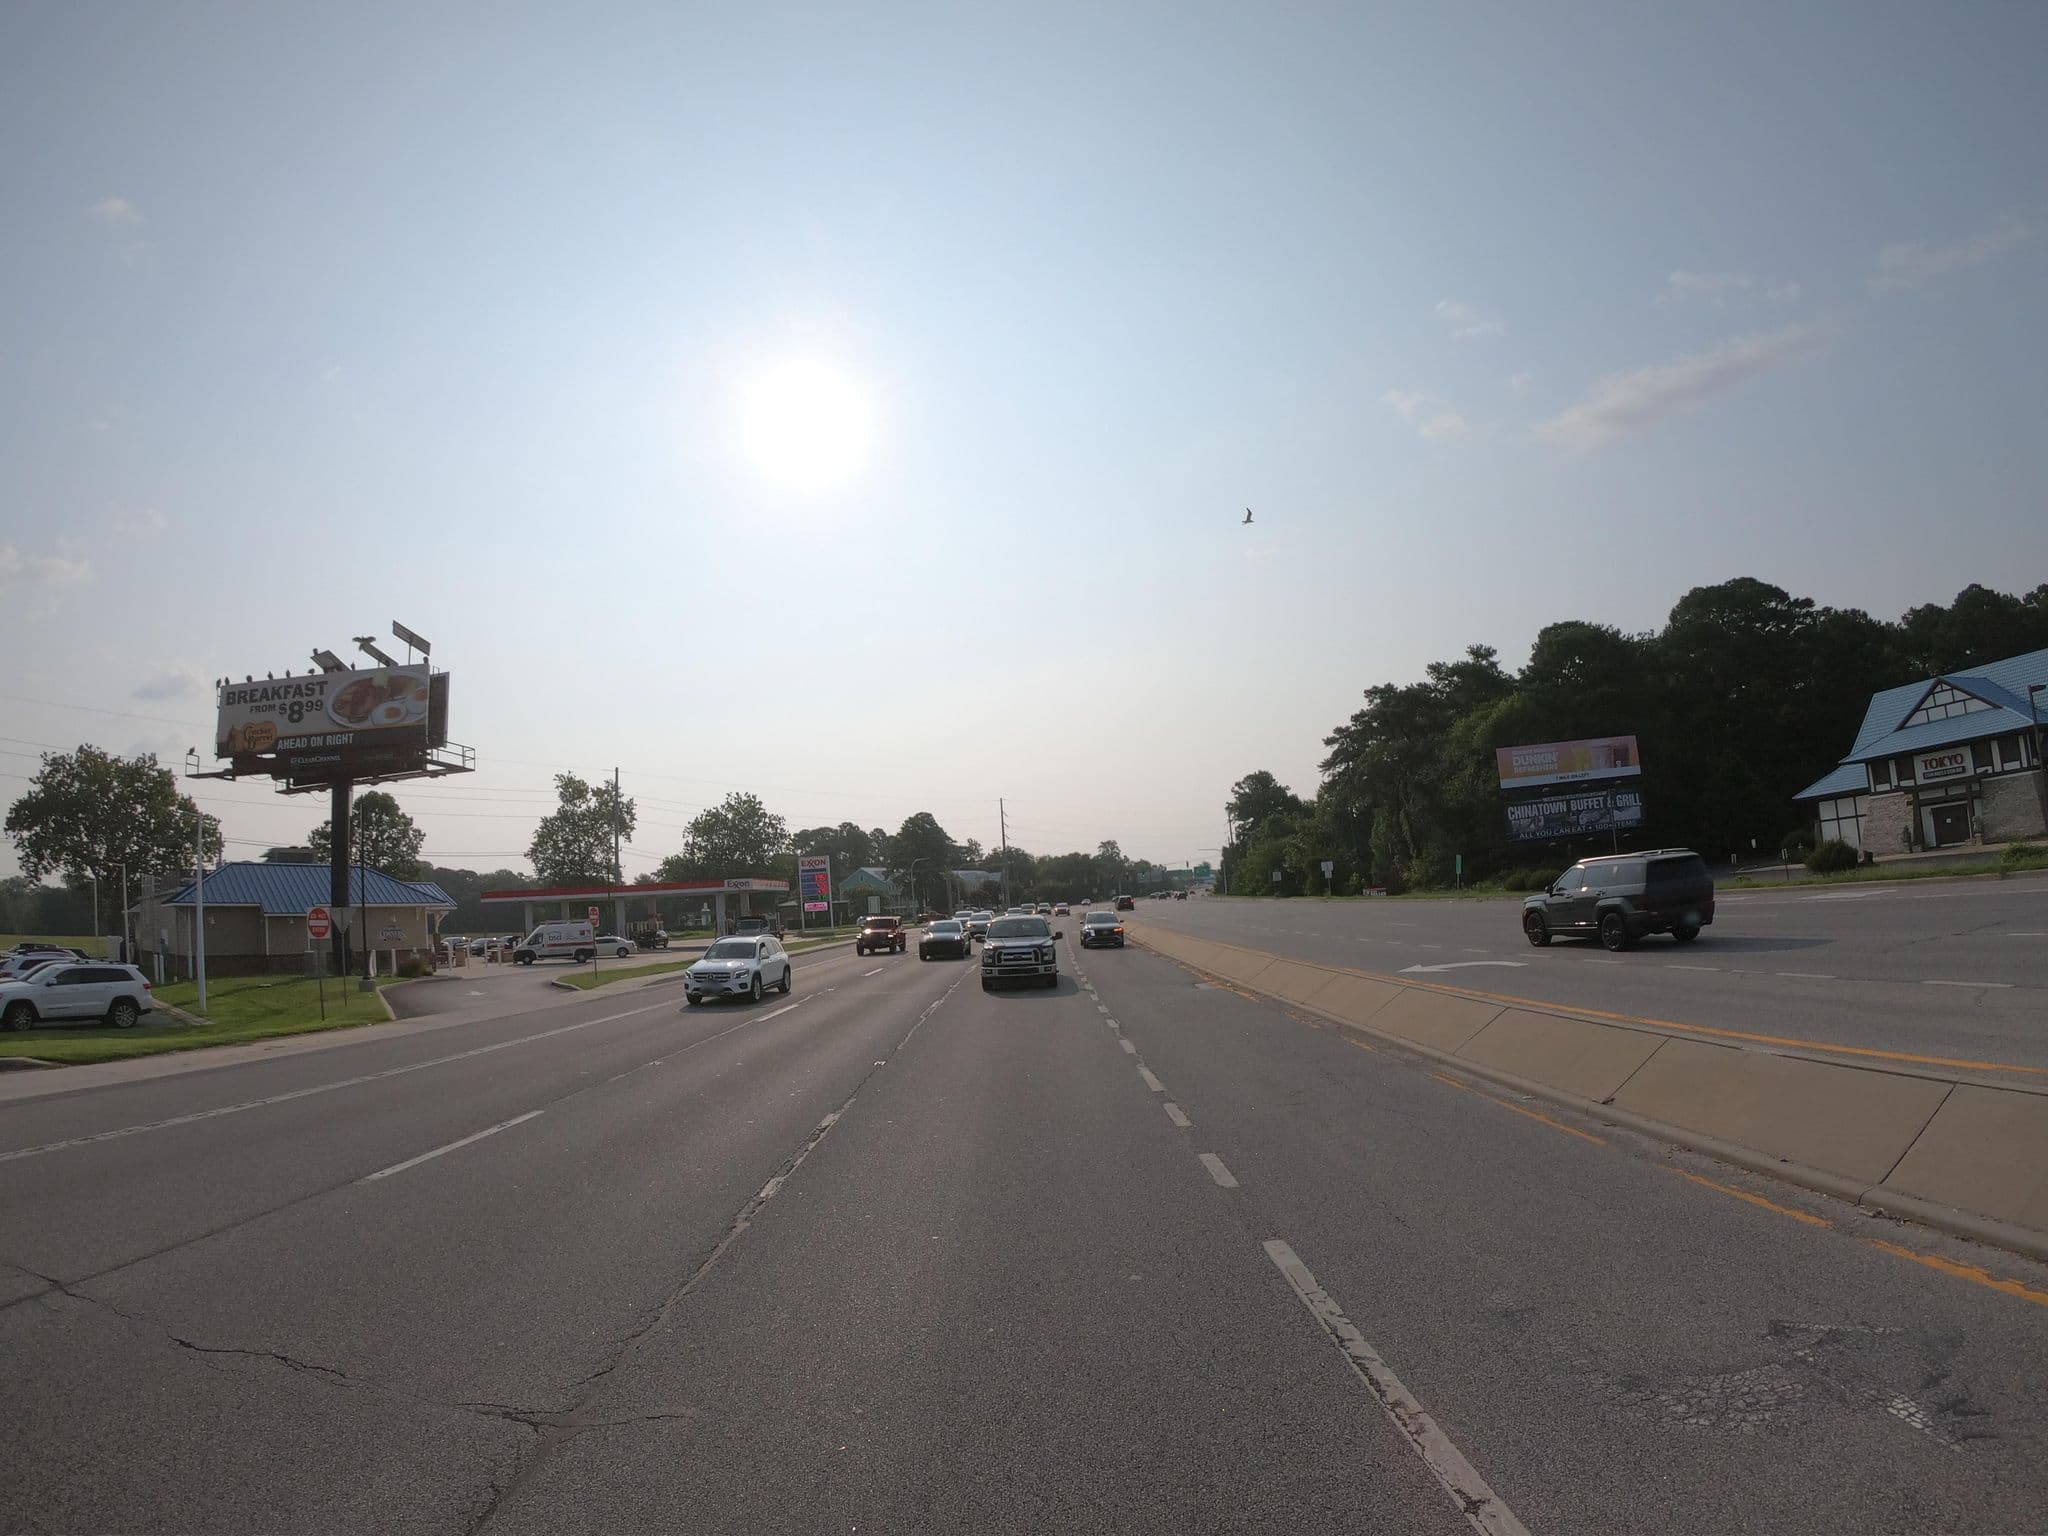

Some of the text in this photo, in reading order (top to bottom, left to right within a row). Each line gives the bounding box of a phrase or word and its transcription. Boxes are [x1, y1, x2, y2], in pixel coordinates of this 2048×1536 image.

[226, 681, 328, 706] BREAKFAST
[250, 704, 276, 714] FROM
[278, 733, 354, 750] AHEAD ON RIGHT
[1921, 753, 1964, 770] TOKYO
[1507, 801, 1567, 820] CHINATOWN
[1570, 796, 1605, 811] BUFFET
[1616, 793, 1642, 807] GRILL
[1536, 830, 1552, 838] YOU
[1554, 828, 1570, 836] CAN
[801, 859, 826, 868] EXXON
[727, 880, 750, 888] Exxon
